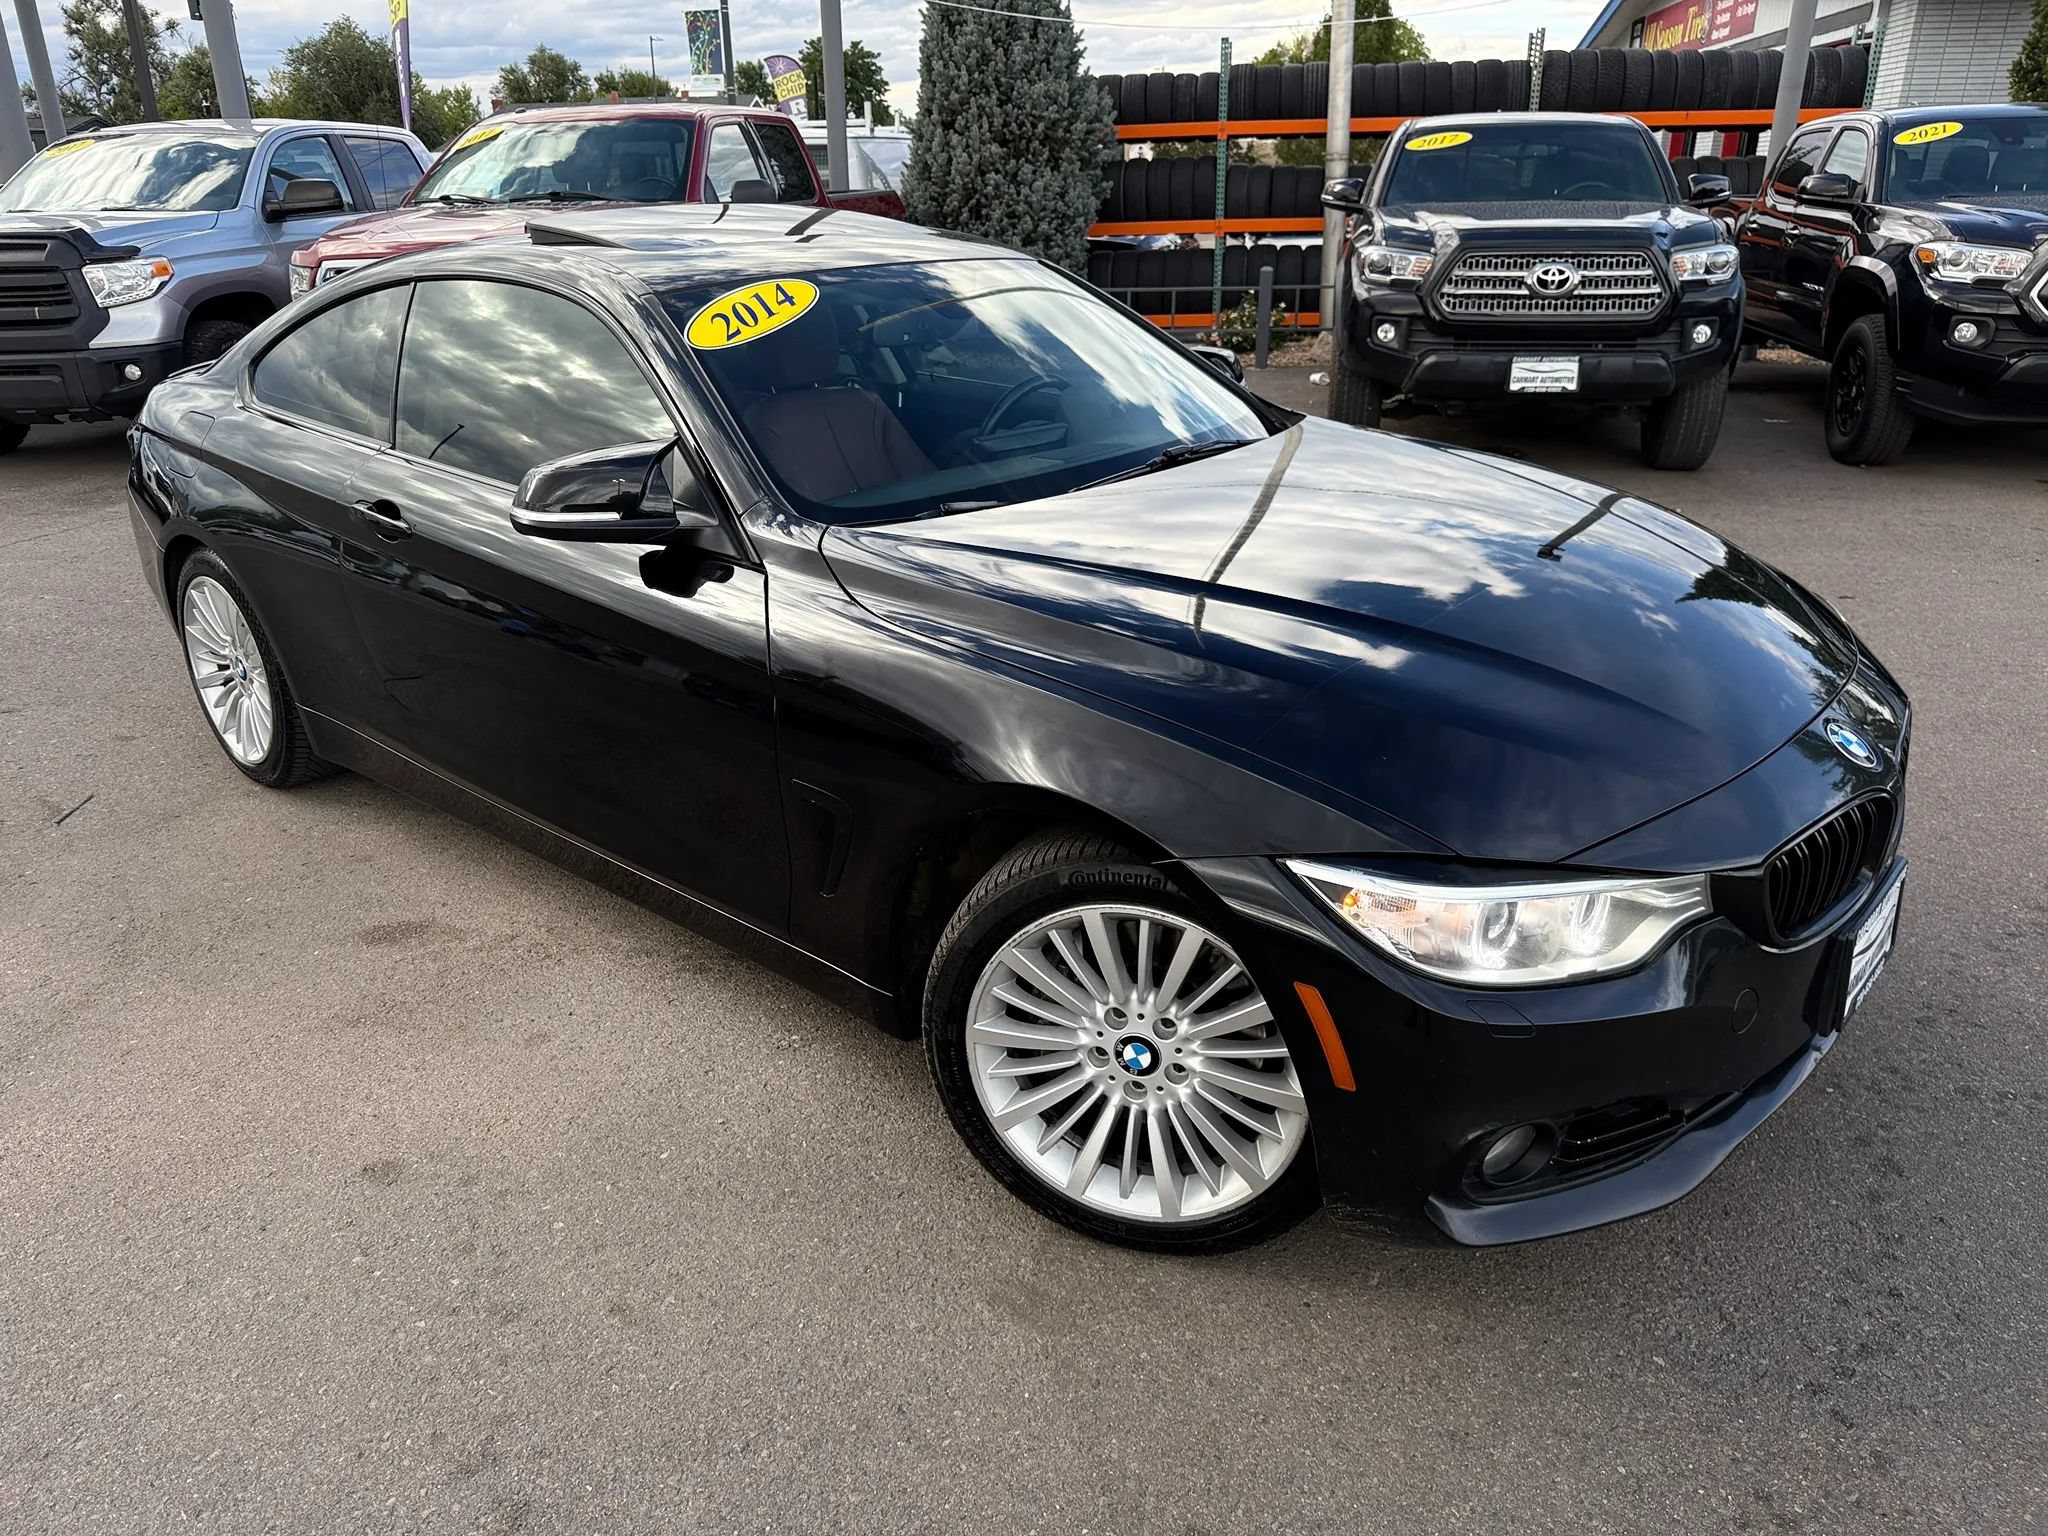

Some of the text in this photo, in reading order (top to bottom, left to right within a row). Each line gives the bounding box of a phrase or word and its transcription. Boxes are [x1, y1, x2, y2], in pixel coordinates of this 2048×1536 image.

[775, 72, 804, 89] ROCK
[780, 83, 805, 99] CHIP
[1416, 133, 1459, 149] 2017
[1908, 123, 1948, 142] 2021
[710, 282, 797, 342] 2014
[1067, 867, 1169, 890] Continental
